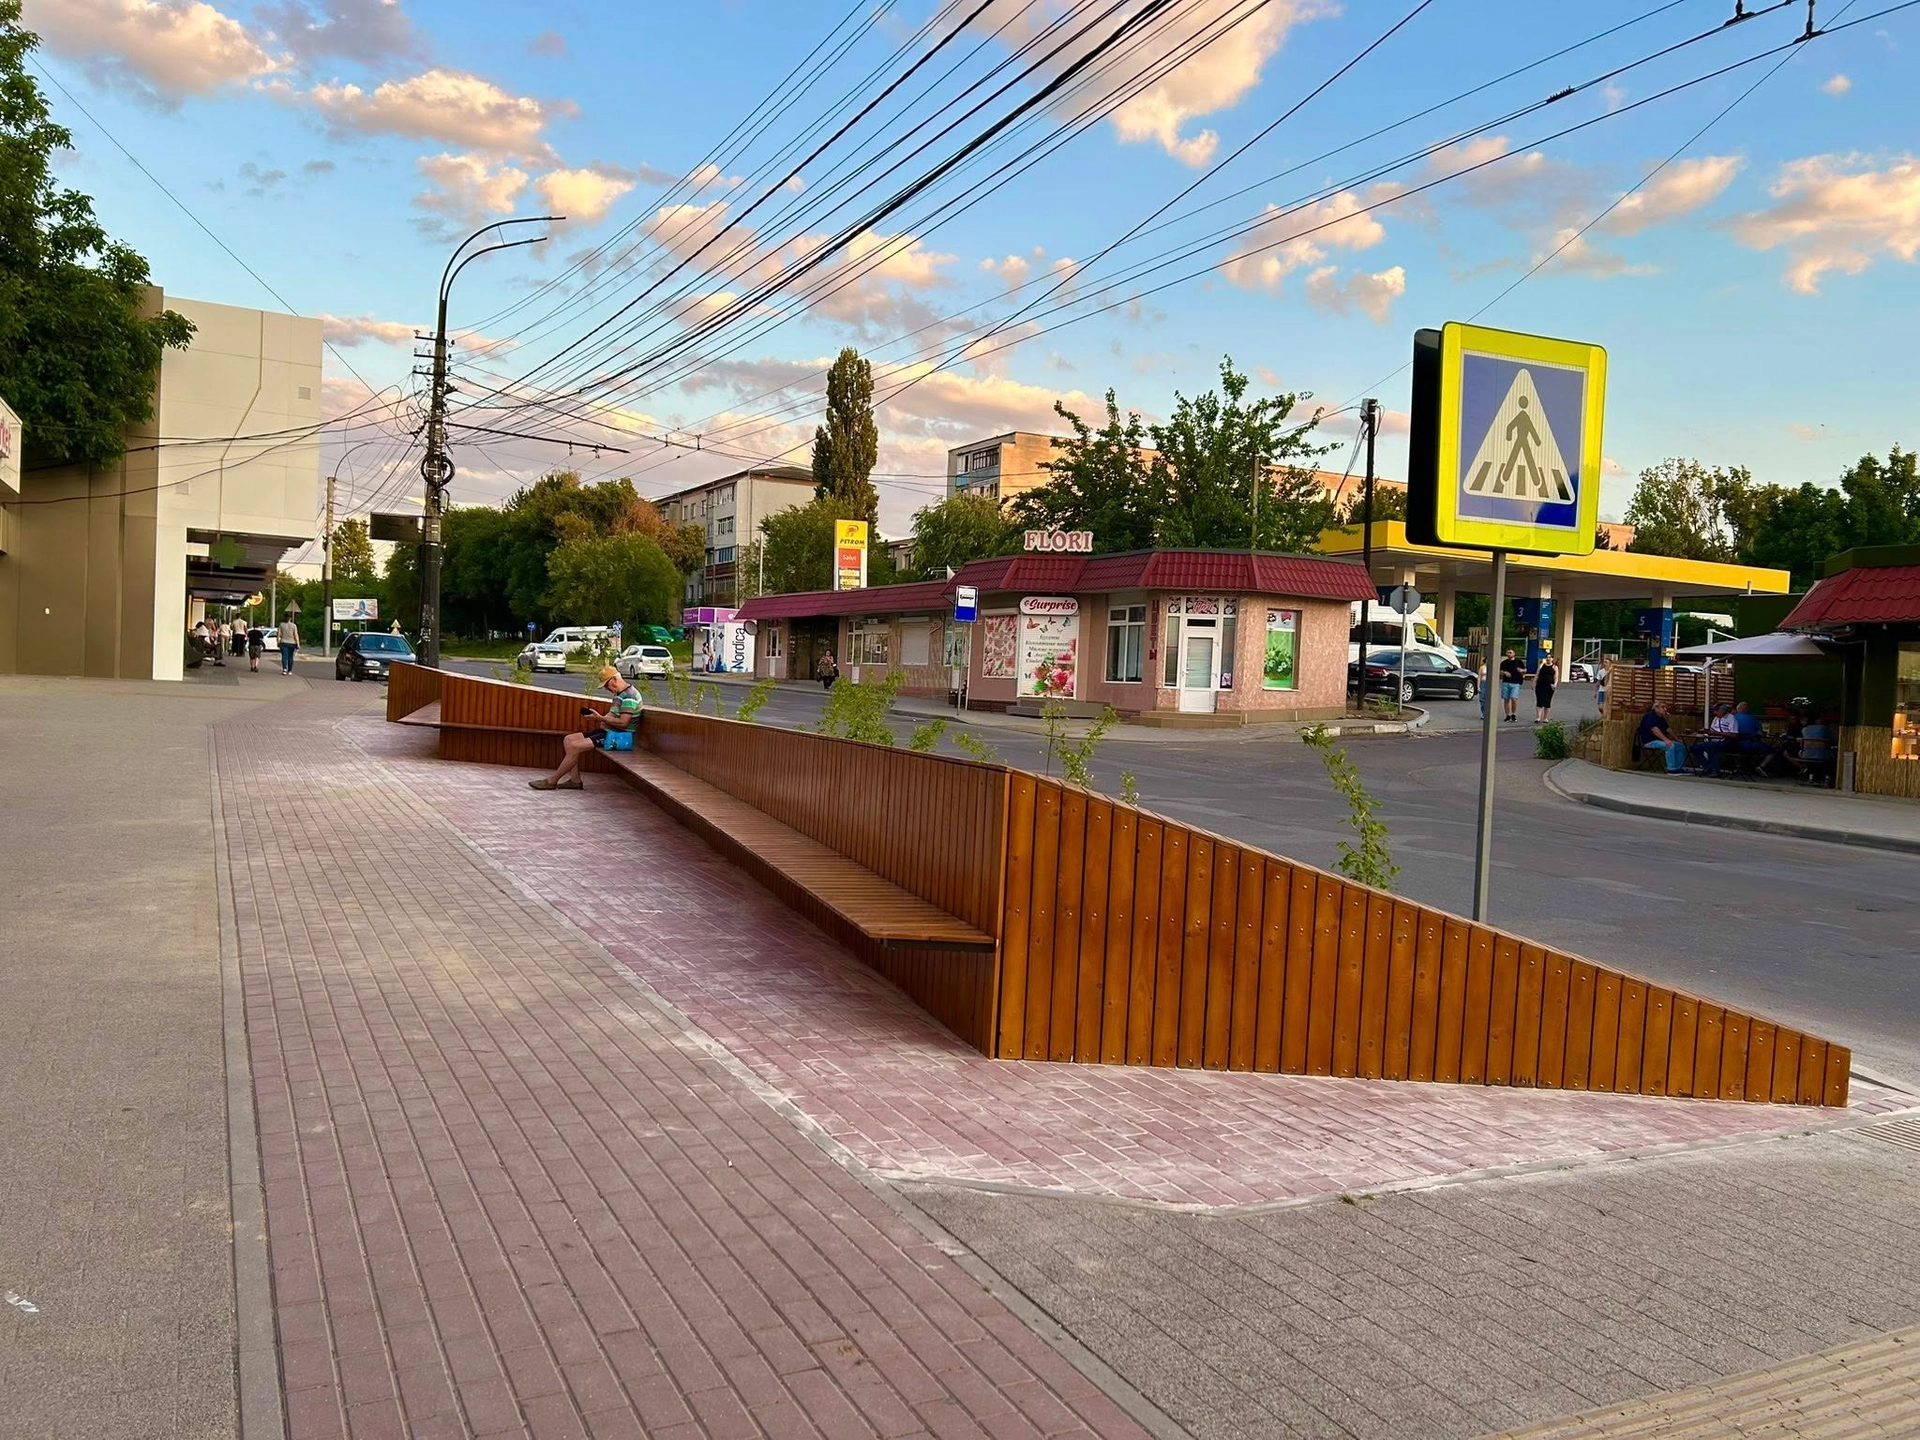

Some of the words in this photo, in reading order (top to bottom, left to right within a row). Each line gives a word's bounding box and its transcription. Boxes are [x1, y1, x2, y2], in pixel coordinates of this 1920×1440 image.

[1024, 531, 1093, 552] FLORI
[1024, 598, 1077, 612] Surprise
[1517, 606, 1525, 618] 3
[1638, 615, 1646, 626] 5
[731, 627, 746, 670] Nordica
